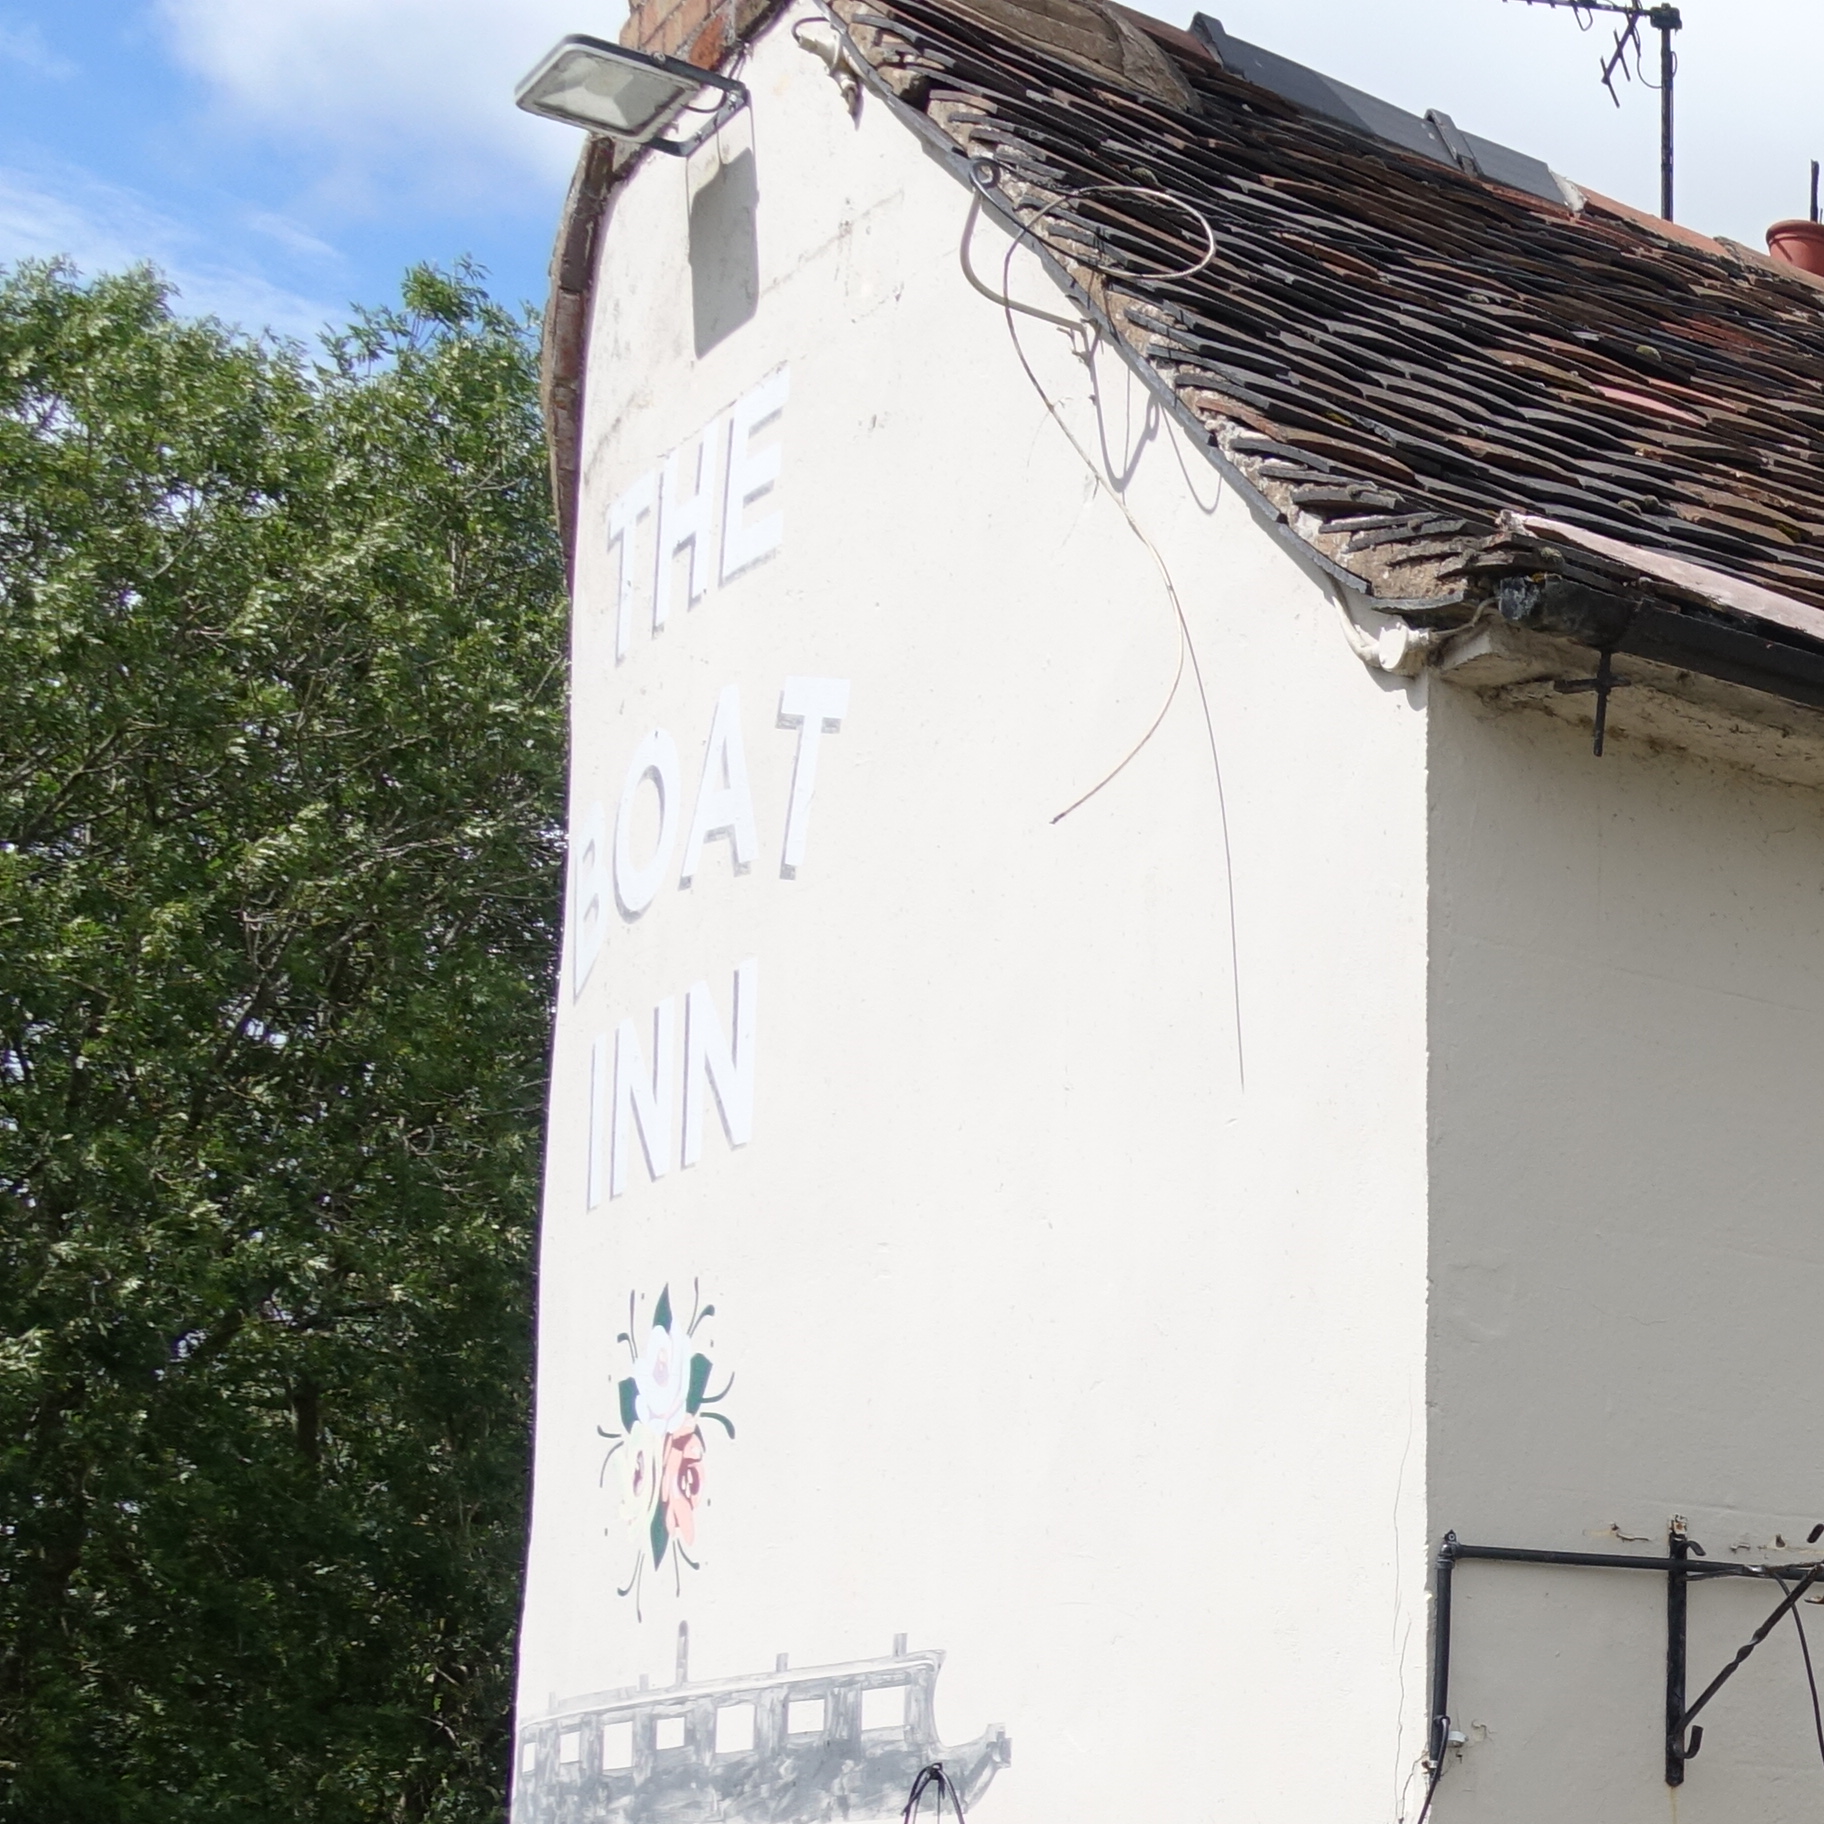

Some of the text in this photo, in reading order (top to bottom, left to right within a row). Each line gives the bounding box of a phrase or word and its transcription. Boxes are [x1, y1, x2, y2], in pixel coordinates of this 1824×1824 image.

[607, 363, 791, 666] THE
[573, 676, 851, 1005] BOAT
[585, 955, 760, 1213] INN
